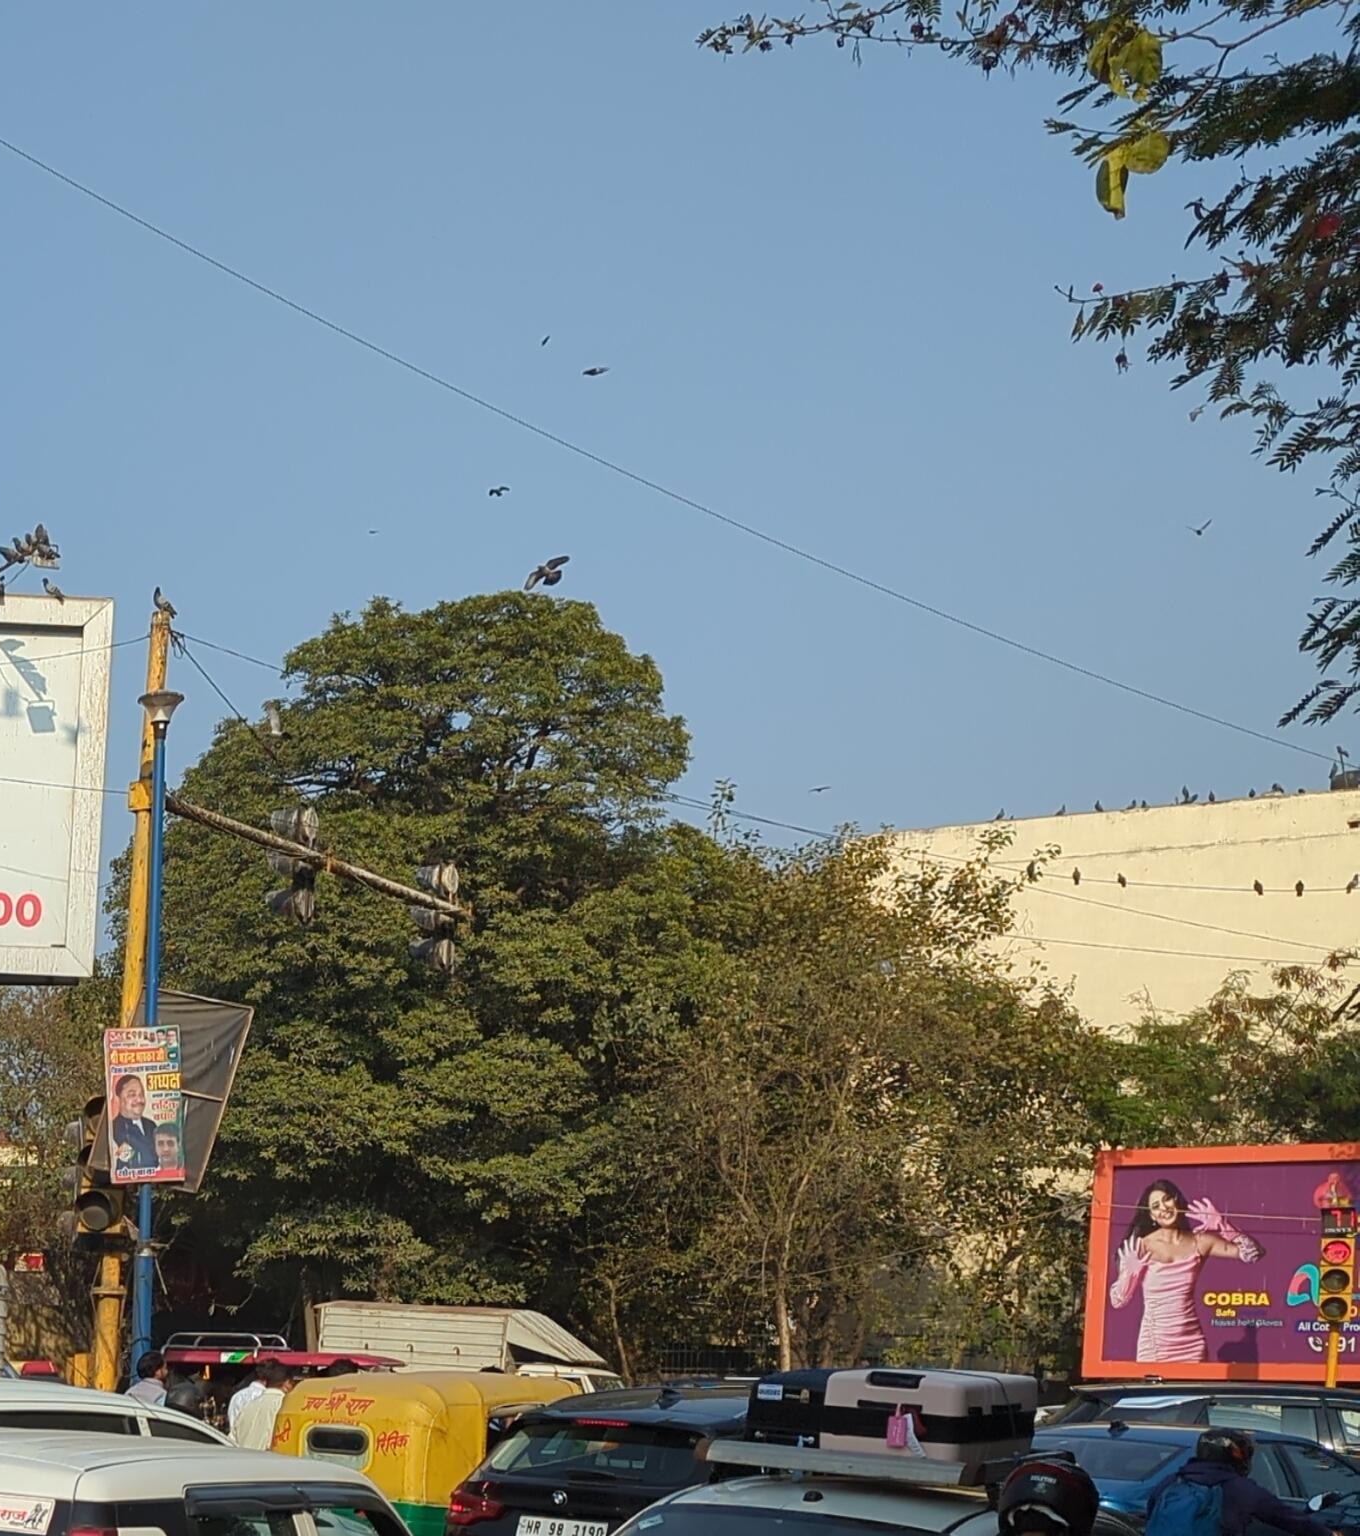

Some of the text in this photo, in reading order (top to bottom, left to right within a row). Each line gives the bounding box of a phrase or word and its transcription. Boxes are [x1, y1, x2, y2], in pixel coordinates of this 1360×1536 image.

[1203, 1292, 1270, 1306] COBRA
[1215, 1308, 1236, 1317] Safe
[1298, 1321, 1311, 1332] All
[301, 1393, 375, 1416] जय श्री राम
[525, 1516, 540, 1535] HR
[548, 1519, 564, 1536] 98
